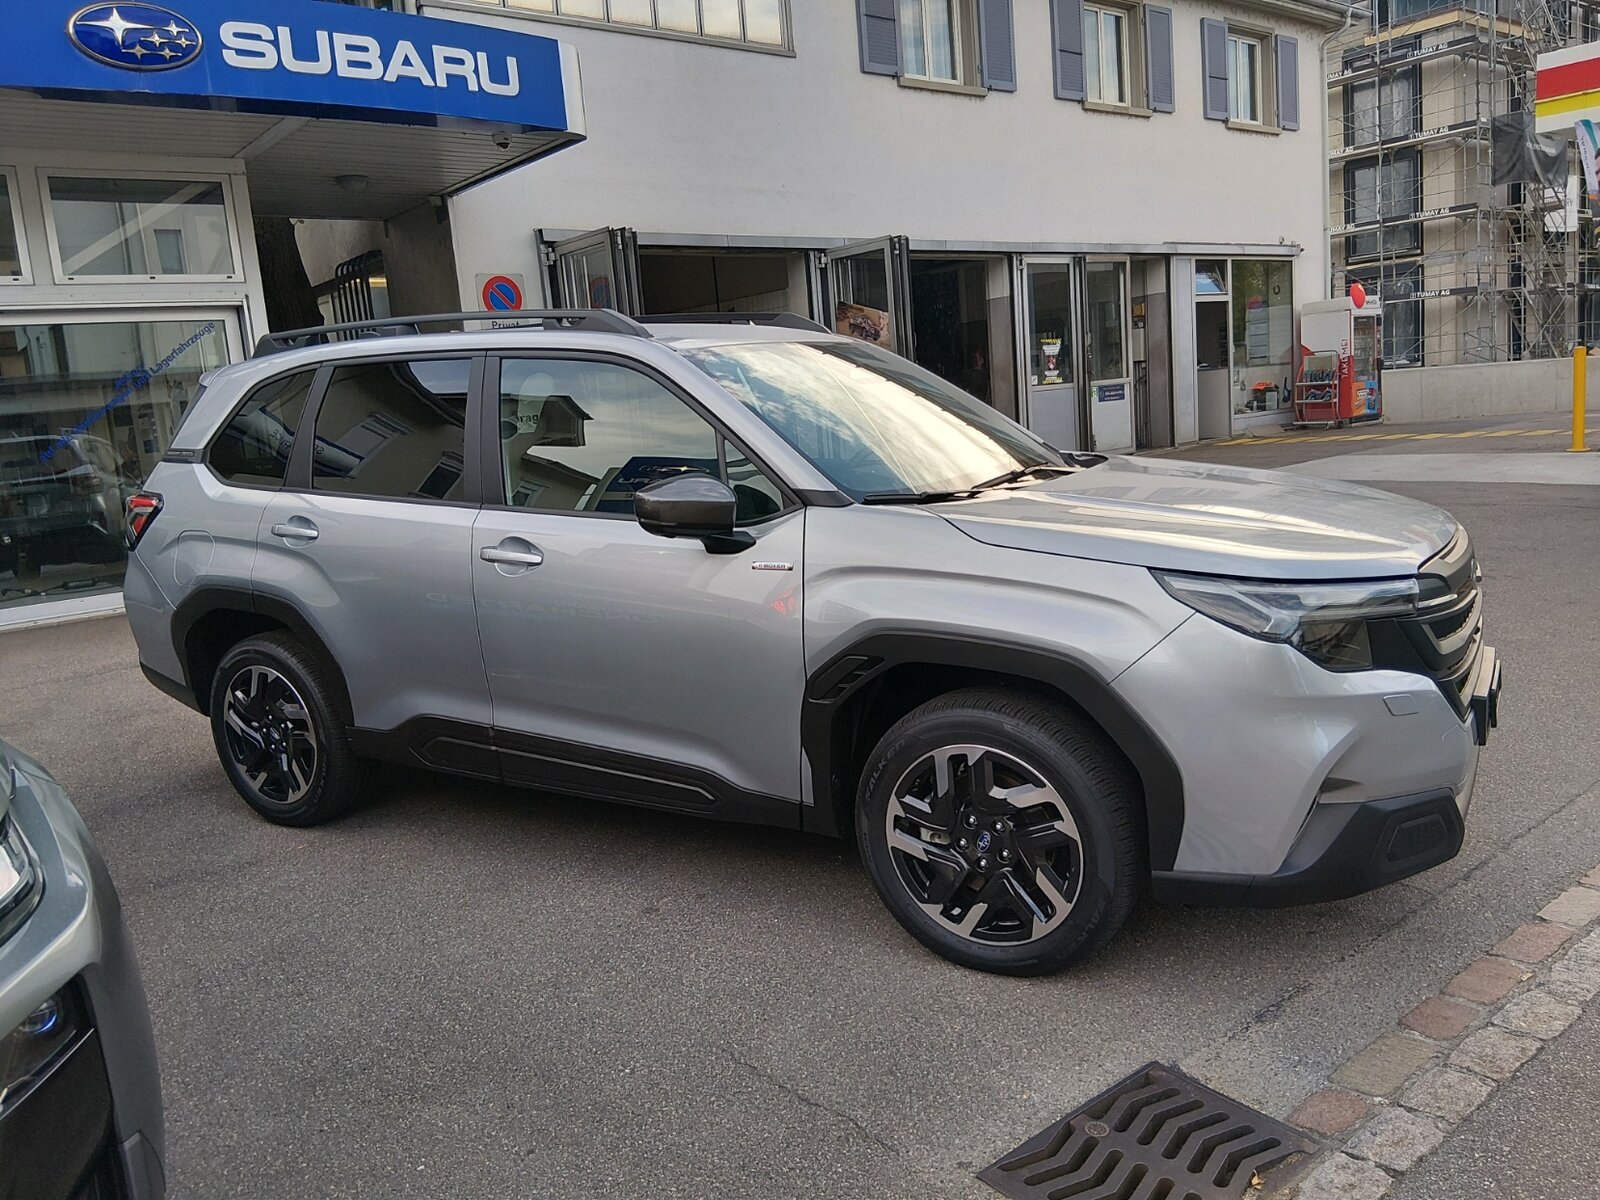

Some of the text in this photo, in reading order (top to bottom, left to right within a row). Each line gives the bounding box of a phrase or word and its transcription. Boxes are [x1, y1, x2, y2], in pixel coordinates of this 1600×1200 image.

[1413, 45, 1438, 57] TUMAY
[1438, 43, 1448, 51] AG
[219, 20, 521, 97] SUBARU
[1414, 128, 1438, 139] TUMAY
[1415, 208, 1439, 218] TUMAY
[1416, 290, 1439, 298] TUMAY
[150, 321, 216, 375] Lagerfahrzeuge
